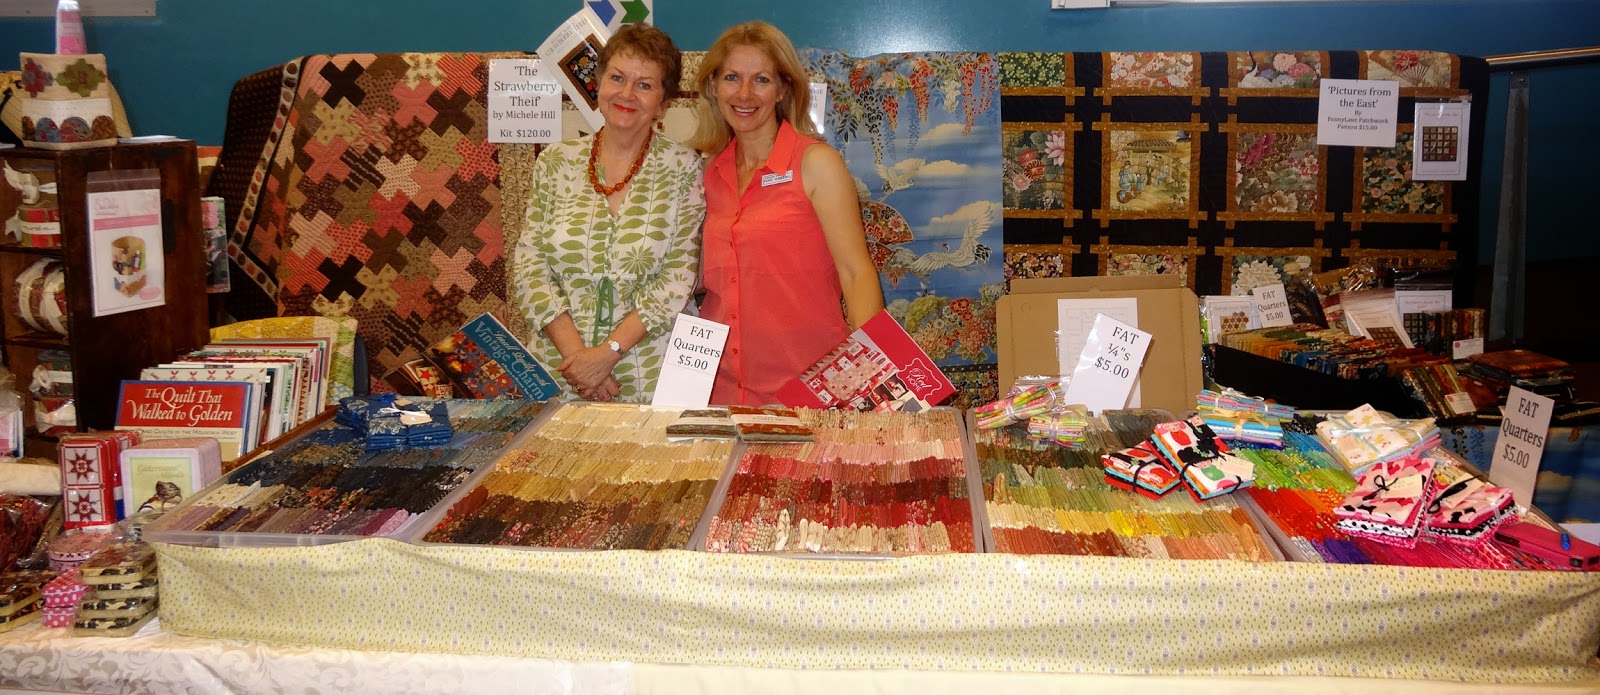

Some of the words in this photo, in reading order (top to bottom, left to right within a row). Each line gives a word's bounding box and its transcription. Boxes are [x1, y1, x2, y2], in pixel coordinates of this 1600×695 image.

[494, 80, 557, 94] Strawberry
[1369, 87, 1391, 97] from
[1340, 98, 1354, 107] the
[492, 110, 504, 120] by
[506, 110, 539, 119] Michele
[540, 110, 556, 119] Hill
[500, 129, 512, 138] Kit
[516, 128, 551, 138] $120.00
[1262, 290, 1276, 300] FAT
[1257, 301, 1287, 313] Quarters
[1265, 311, 1284, 321] $5.00
[690, 325, 714, 340] FAT
[1112, 326, 1140, 345] FAT
[673, 337, 721, 358] Quarters
[474, 320, 511, 361] Vintage
[511, 360, 545, 400] Charm
[677, 354, 708, 370] $5.00
[1094, 356, 1130, 379] $5.00
[905, 375, 923, 393] HOME
[908, 367, 933, 388] Red
[145, 388, 161, 399] The
[160, 386, 196, 409] Quilt
[197, 389, 223, 404] That
[126, 399, 174, 420] Walked
[175, 410, 187, 420] to
[187, 403, 233, 427] Golden
[1518, 397, 1540, 418] FAT
[1502, 417, 1544, 448] Quarters
[1502, 443, 1530, 469] $5.00
